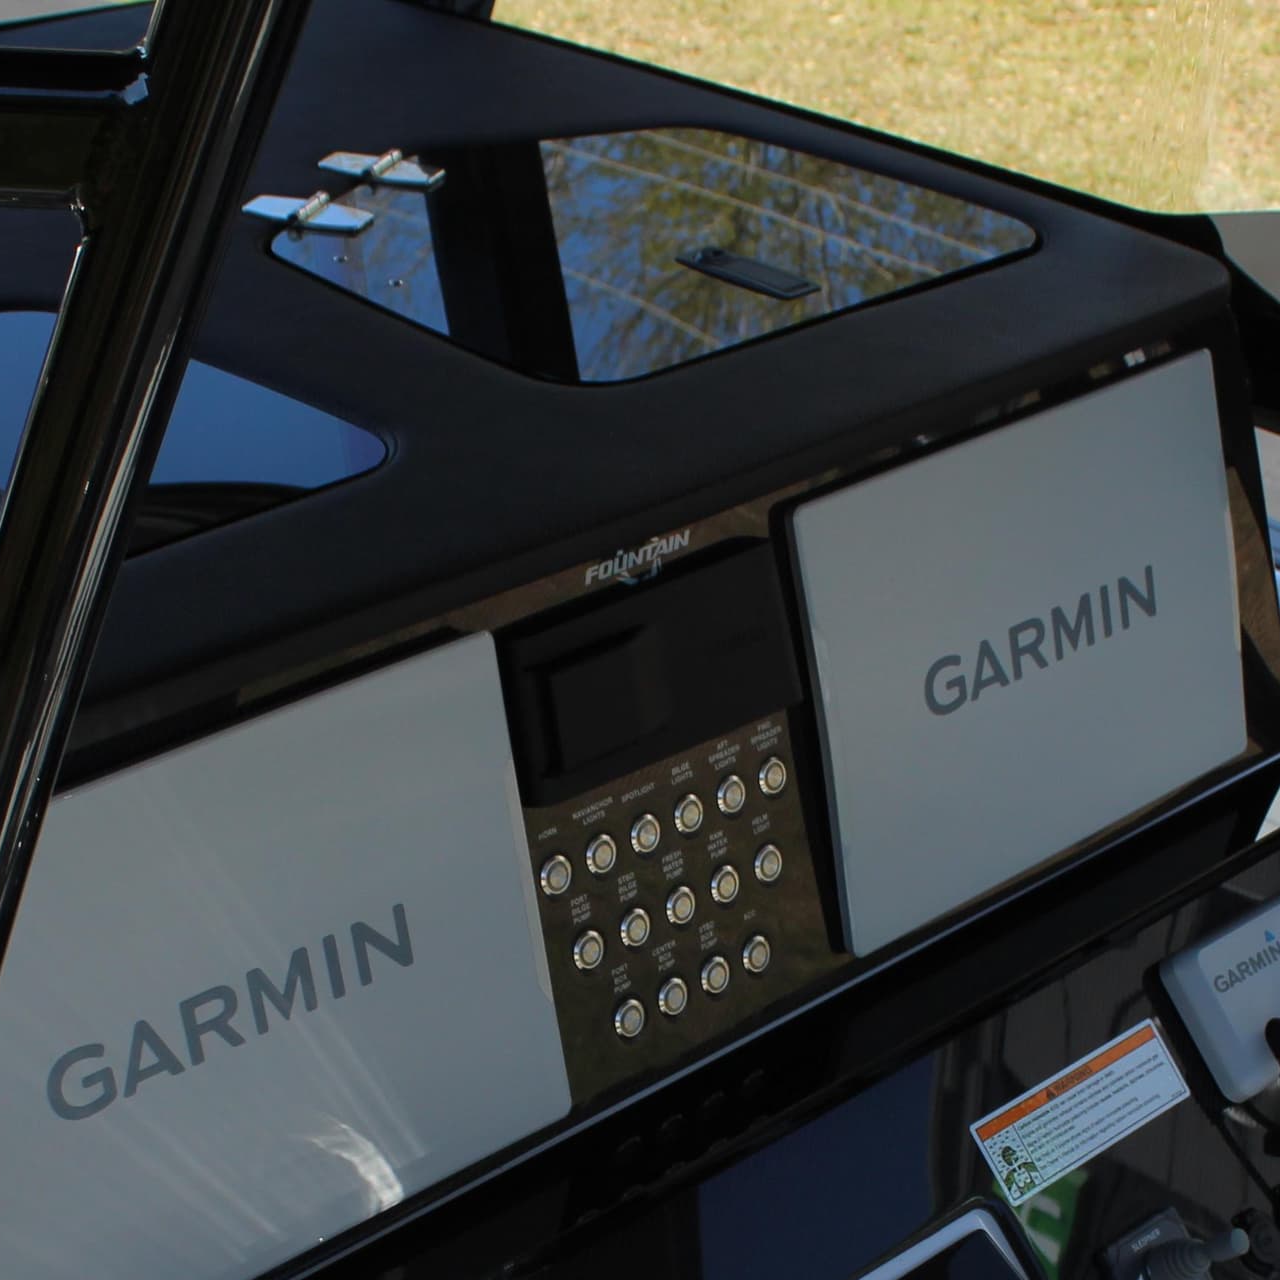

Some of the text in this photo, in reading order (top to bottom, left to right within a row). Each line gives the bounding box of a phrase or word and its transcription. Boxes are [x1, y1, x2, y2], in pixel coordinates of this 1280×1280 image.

[584, 528, 690, 587] FOUNTAIN
[923, 564, 1157, 717] GARMIN
[582, 810, 606, 825] LIGHTS
[621, 782, 655, 803] SPOTLIGHT
[46, 902, 415, 1121] GARMIN
